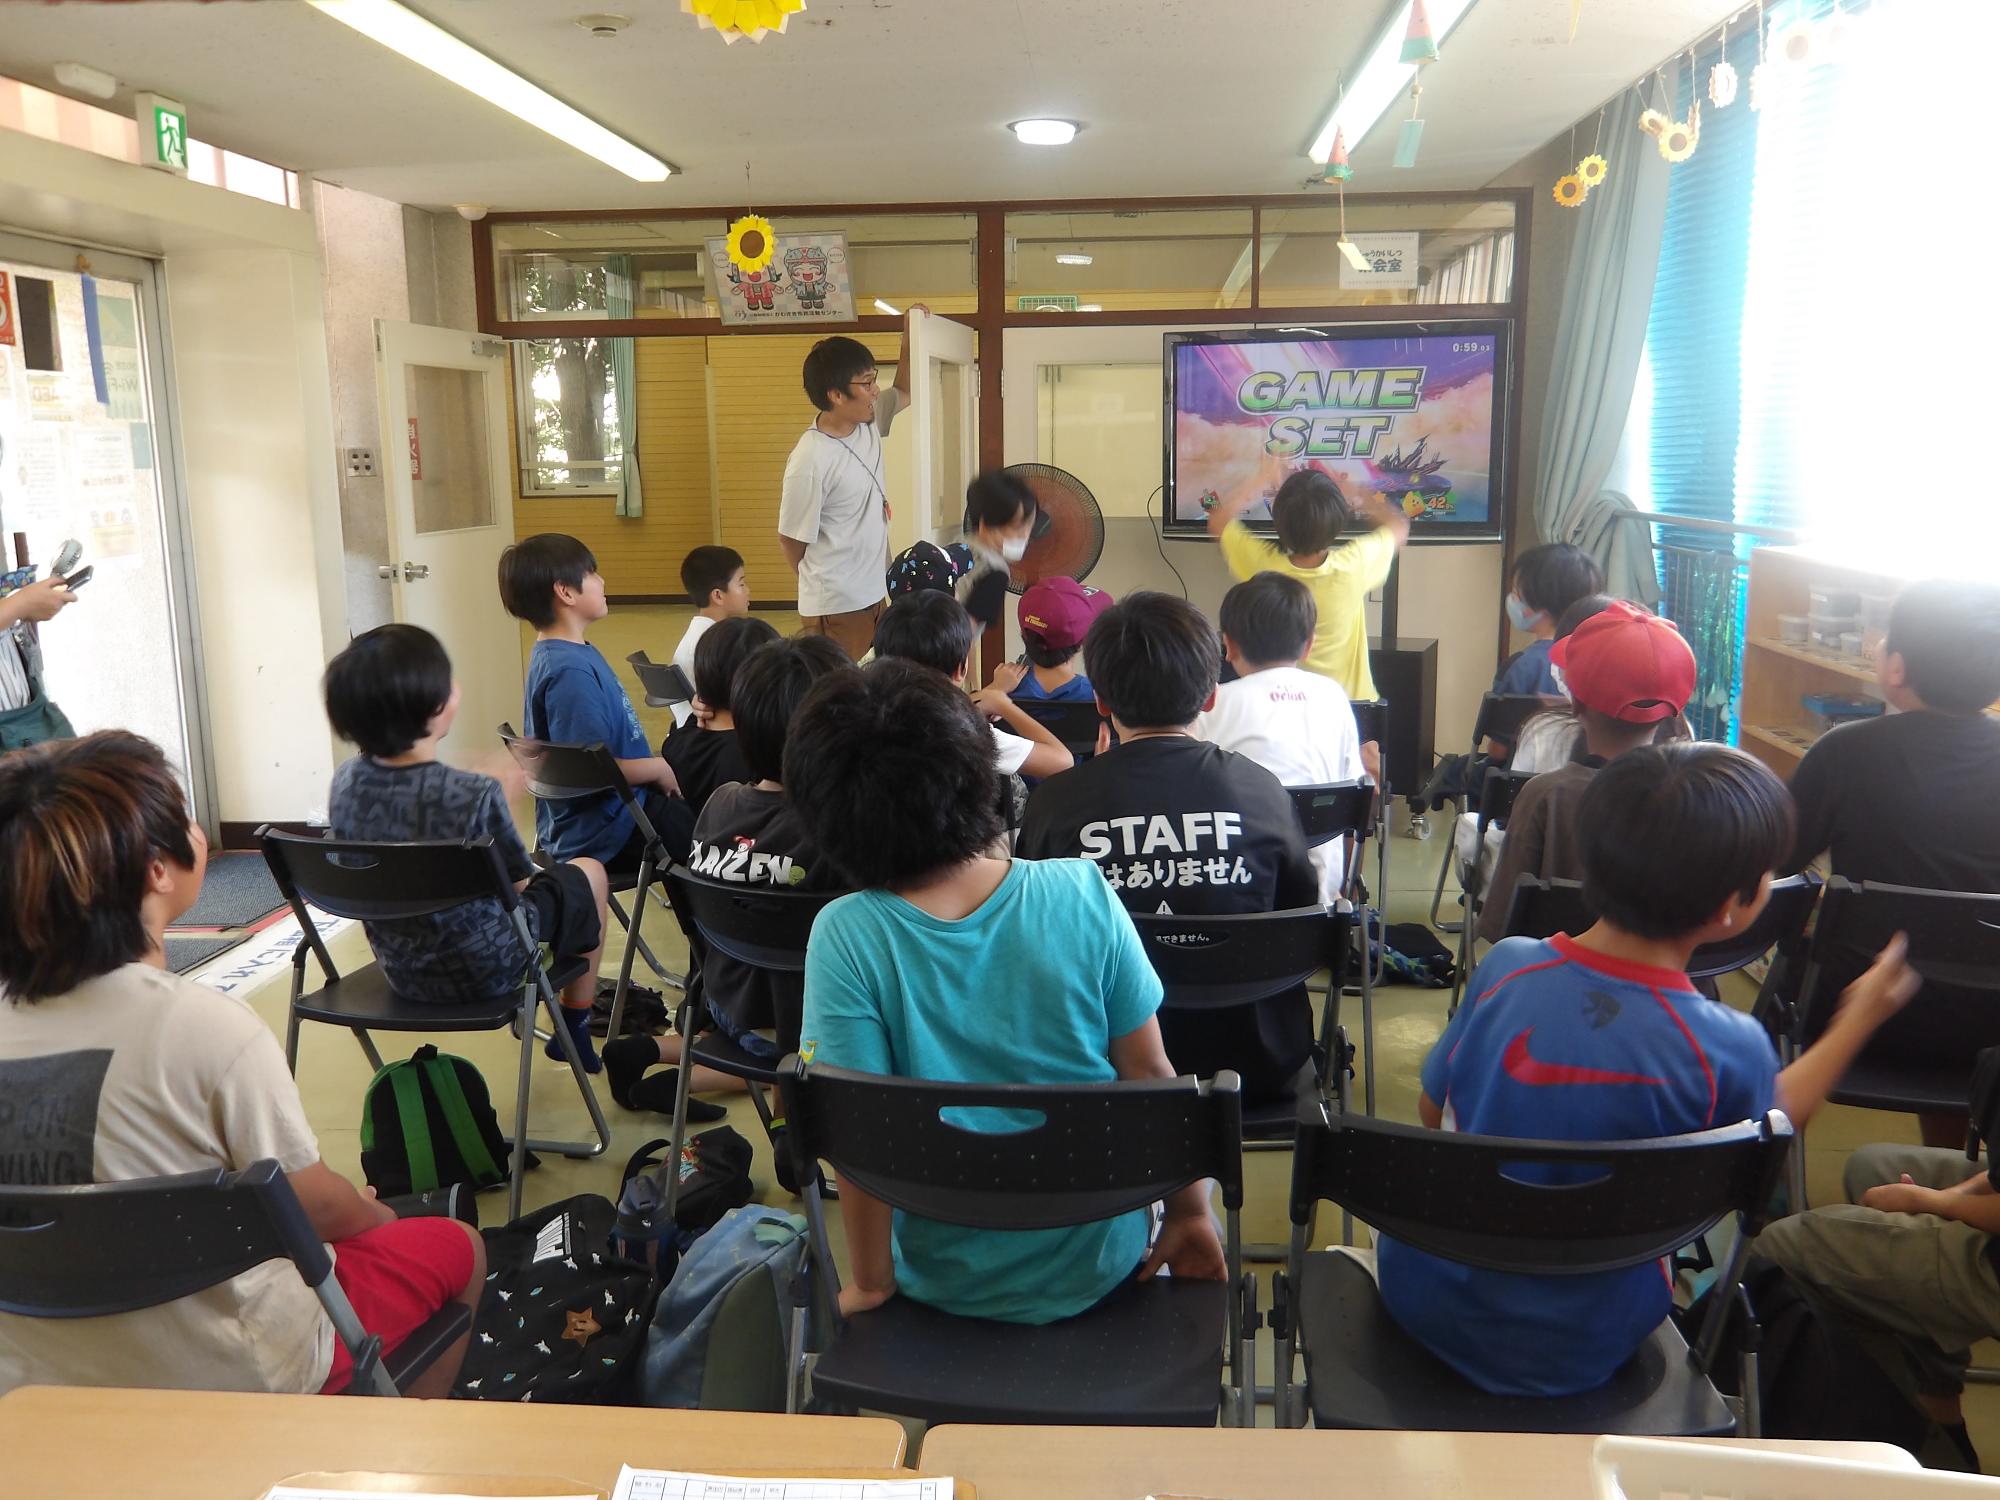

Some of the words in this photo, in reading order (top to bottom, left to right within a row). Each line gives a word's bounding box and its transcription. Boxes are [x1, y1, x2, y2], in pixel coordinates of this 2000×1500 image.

[1358, 258, 1402, 273] 会室
[1361, 249, 1402, 257] ゅうかいしつ
[1238, 367, 1425, 413] GAME
[1266, 415, 1393, 457] SET
[1079, 811, 1243, 860] STAFF
[1100, 855, 1253, 890] はありません
